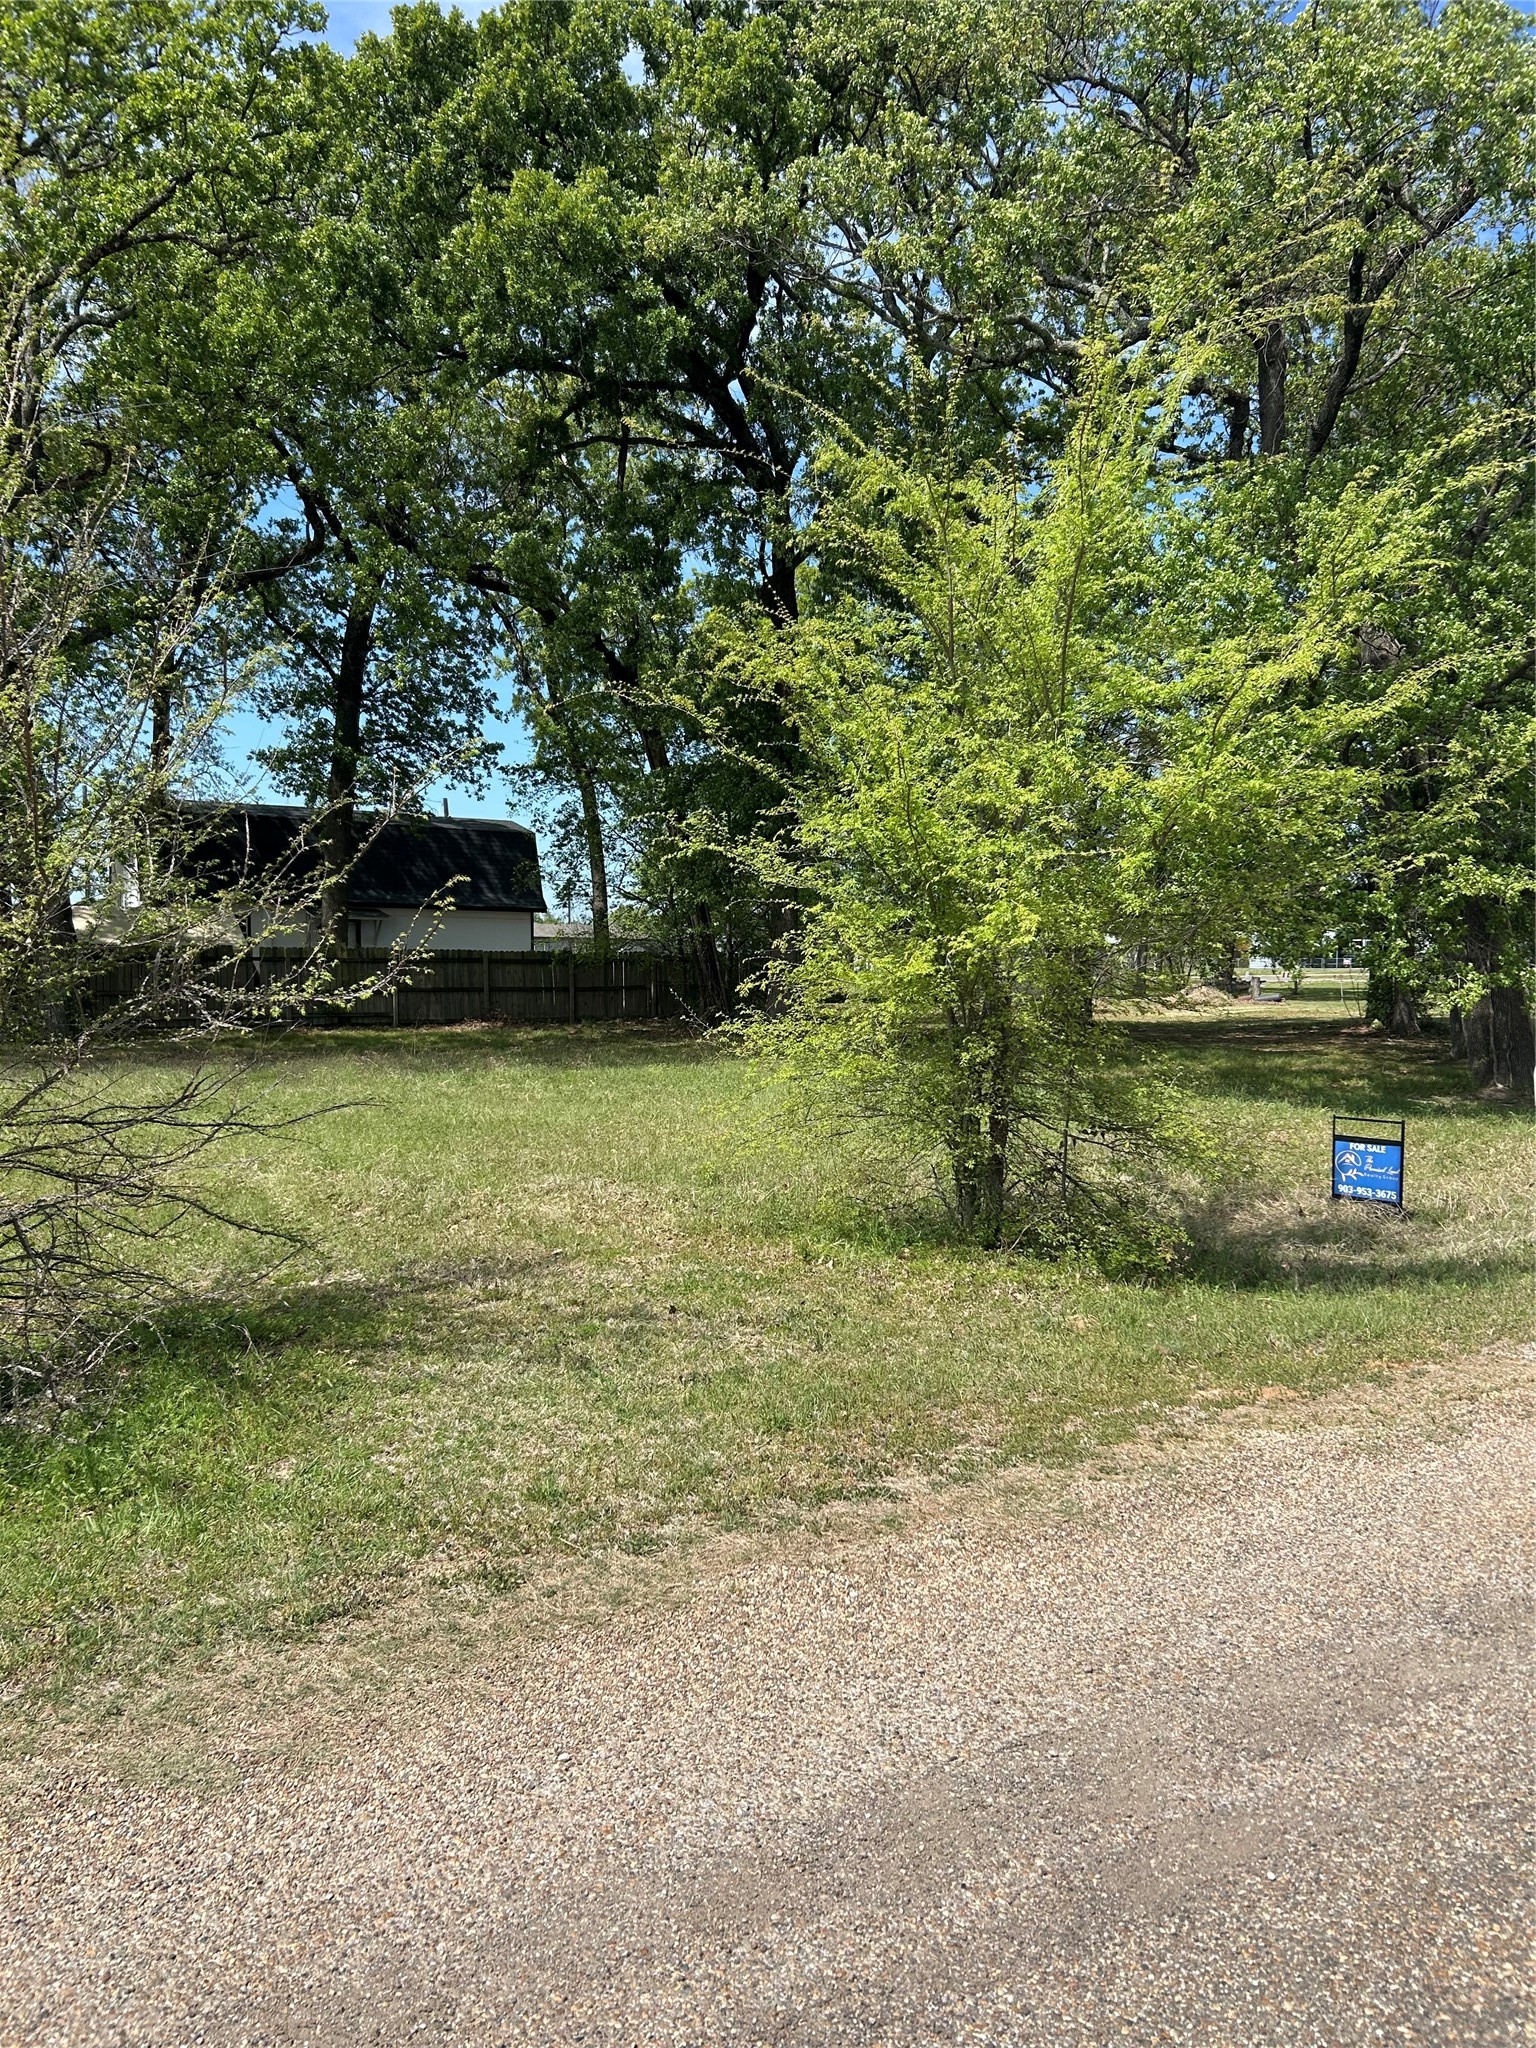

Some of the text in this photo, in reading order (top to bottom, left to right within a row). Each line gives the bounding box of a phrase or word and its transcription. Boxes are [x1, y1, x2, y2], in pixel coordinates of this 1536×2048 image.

[1349, 1143, 1386, 1153] FOR SALE
[1338, 1184, 1397, 1199] 903-953-3675
